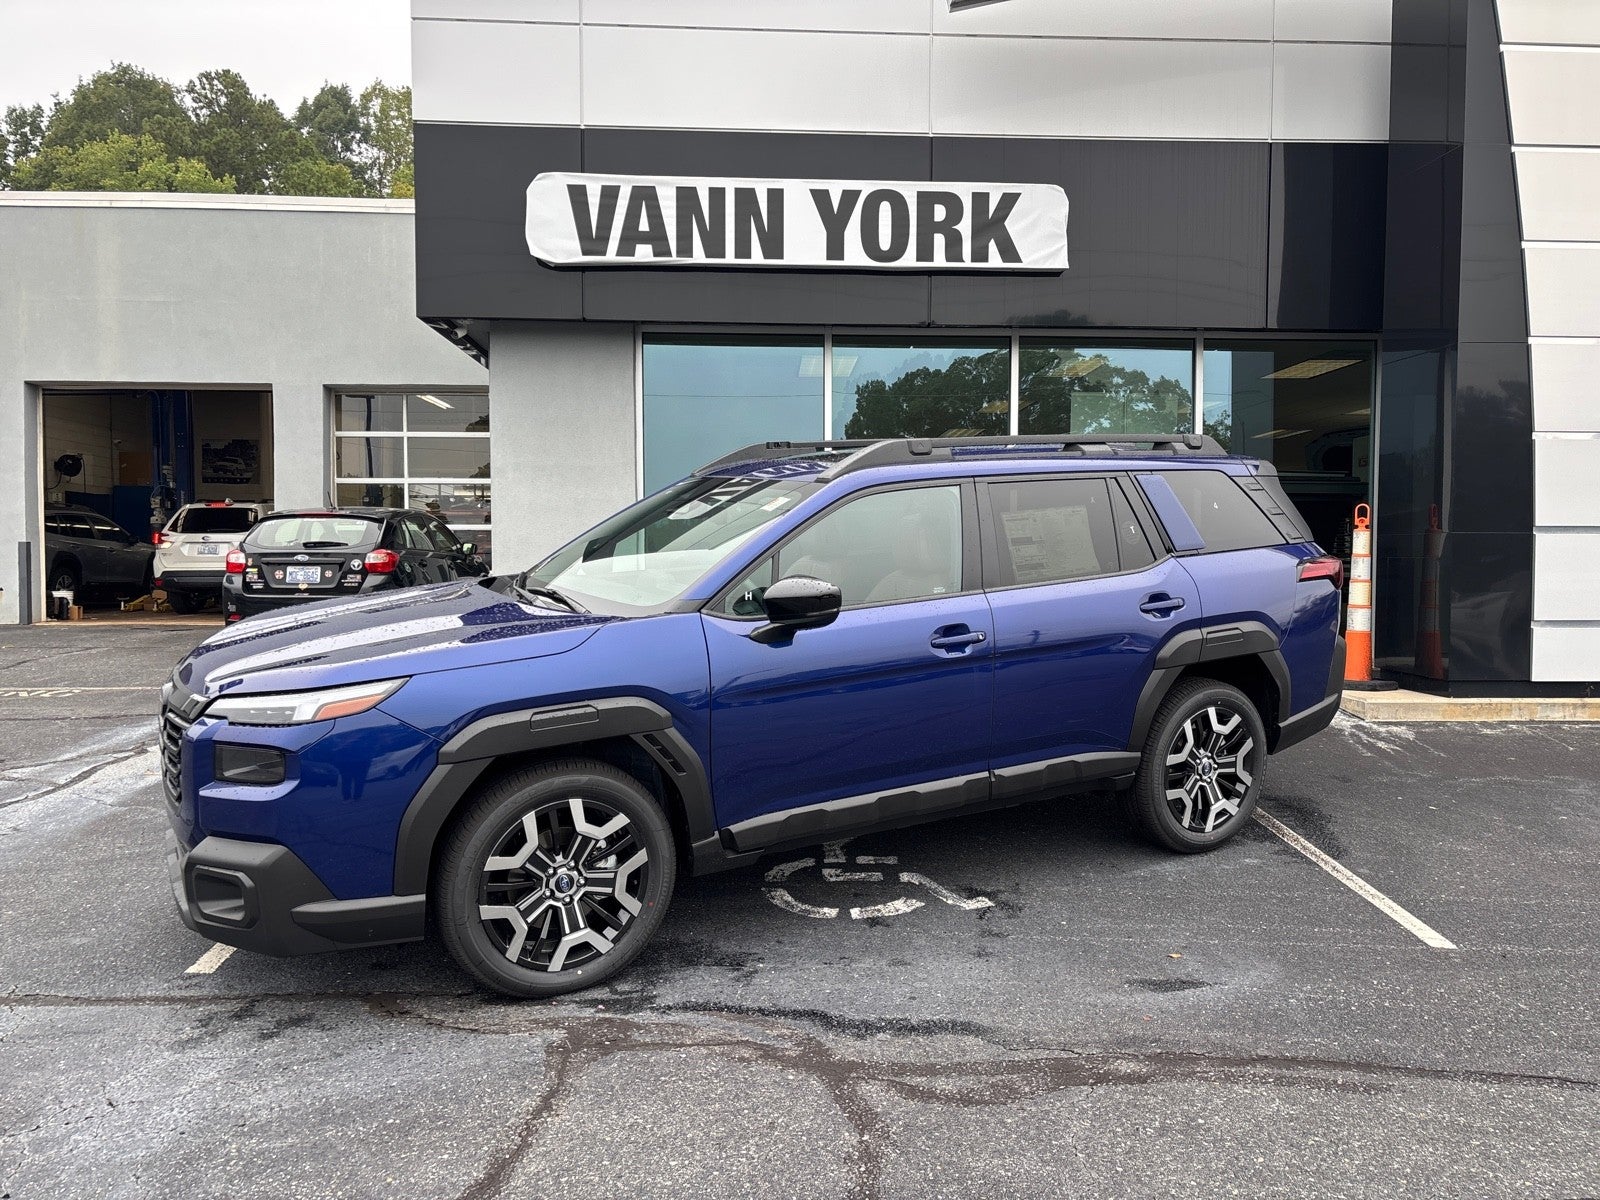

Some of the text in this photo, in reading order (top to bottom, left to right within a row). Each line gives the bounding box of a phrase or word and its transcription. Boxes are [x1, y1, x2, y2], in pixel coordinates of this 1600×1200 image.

[567, 184, 1023, 264] VANN YORK
[745, 591, 752, 601] H
